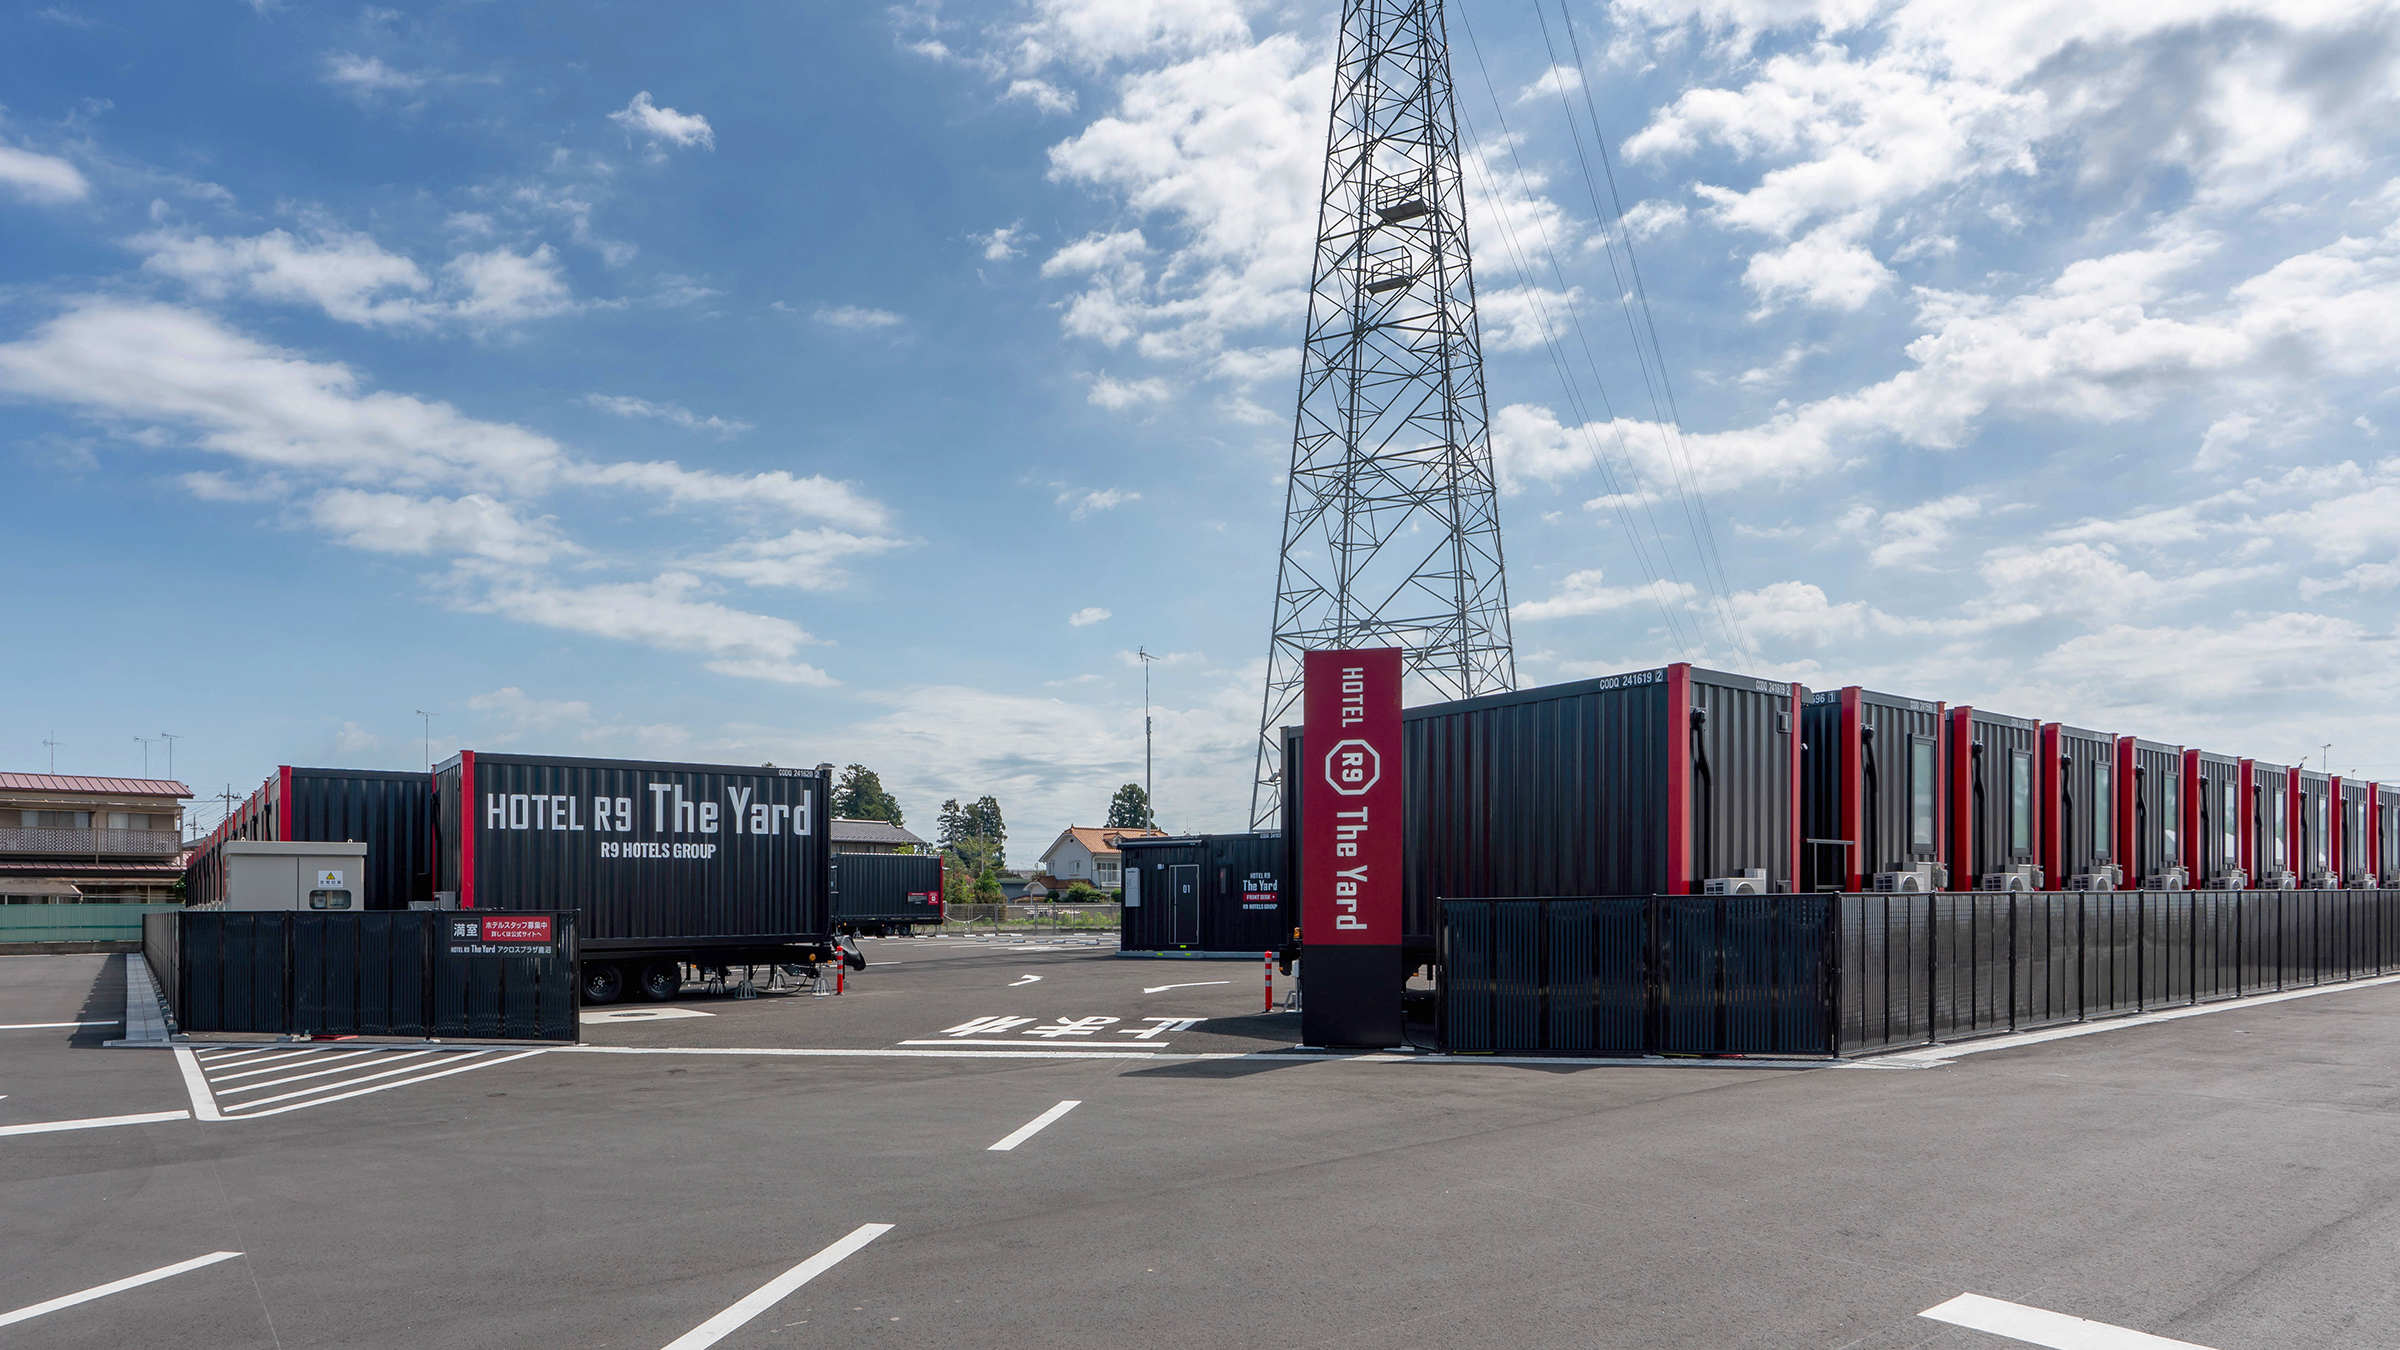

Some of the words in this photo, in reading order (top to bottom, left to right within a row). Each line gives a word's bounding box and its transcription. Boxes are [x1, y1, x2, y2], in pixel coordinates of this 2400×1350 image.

[1599, 678, 1620, 690] CODQ
[1622, 672, 1652, 687] 241619
[1342, 667, 1363, 728] HOTEL
[1342, 752, 1363, 782] R9
[487, 793, 584, 831] HOTEL
[594, 796, 632, 832] R9
[648, 783, 719, 834] The
[727, 786, 812, 836] Yard
[1336, 807, 1368, 857] The
[600, 842, 619, 858] R9
[622, 842, 670, 858] HOTELS
[673, 843, 716, 860] GROUP
[1183, 885, 1191, 893] 01
[1243, 880, 1257, 891] The
[1259, 879, 1278, 891] Yard
[1336, 865, 1368, 930] Yard
[454, 923, 478, 937] 満室
[485, 921, 547, 929] ホテルスタッフ募集中
[471, 944, 482, 953] The
[482, 944, 496, 953] Yard
